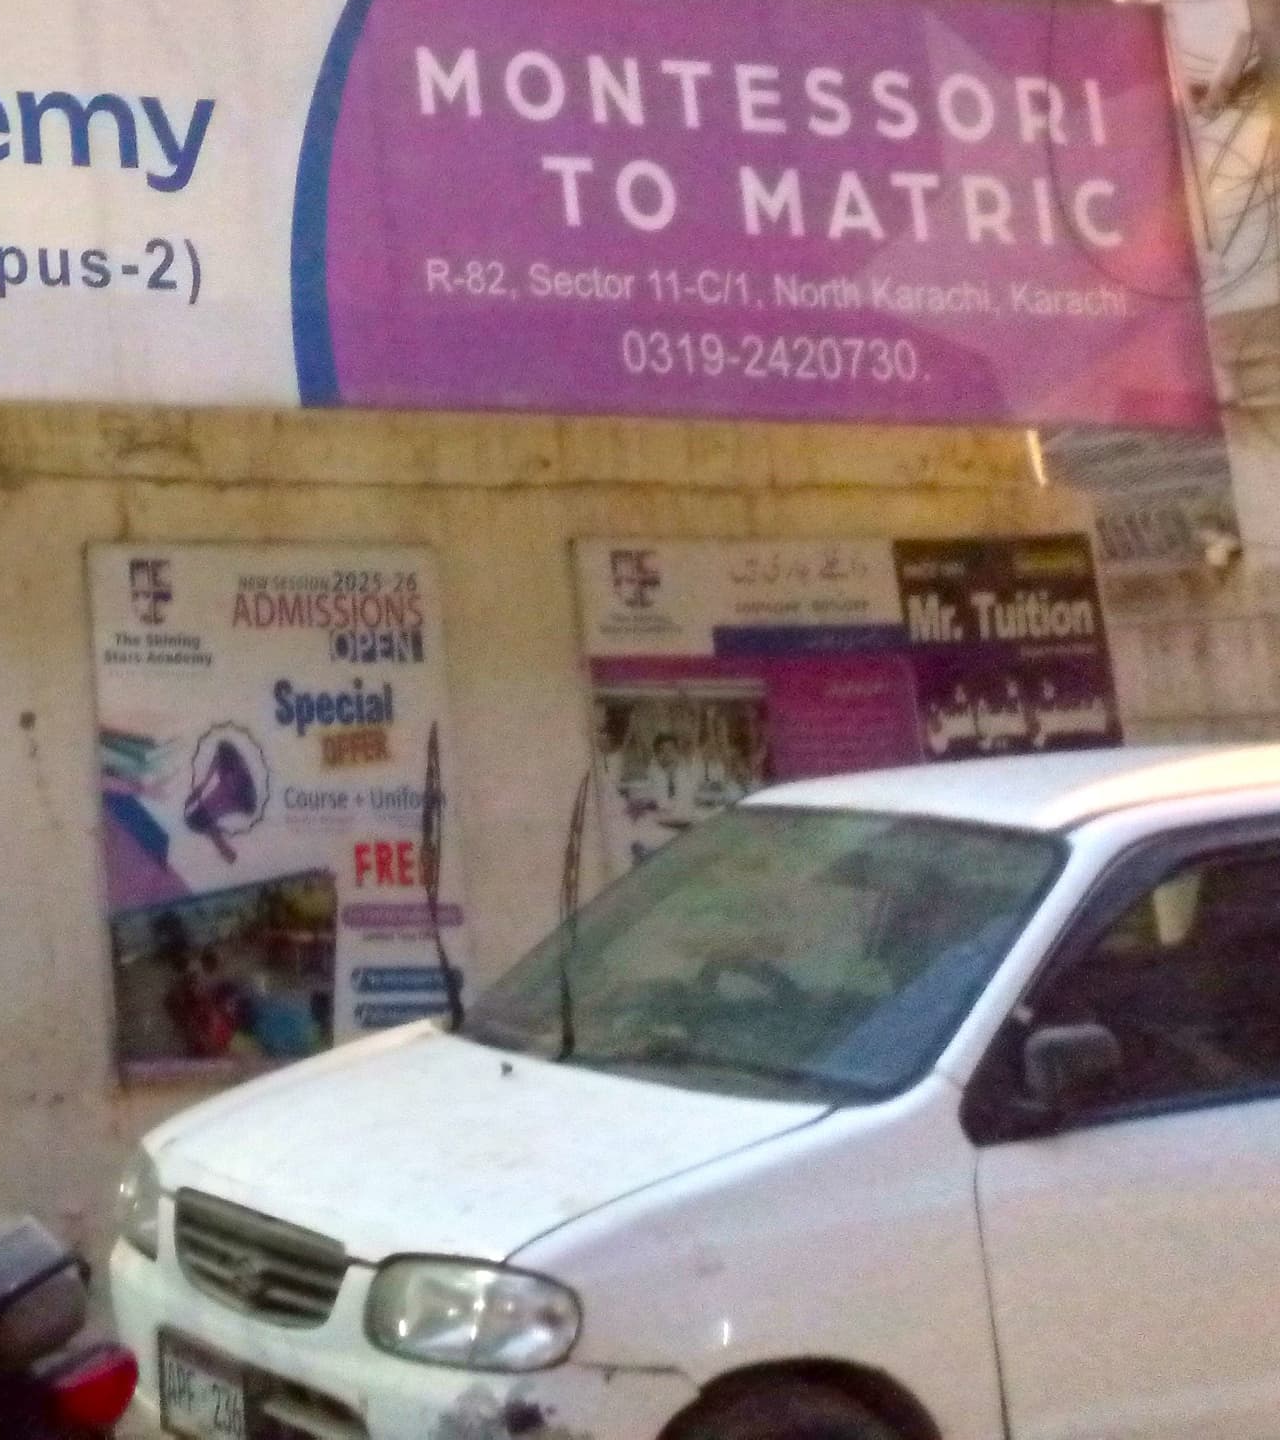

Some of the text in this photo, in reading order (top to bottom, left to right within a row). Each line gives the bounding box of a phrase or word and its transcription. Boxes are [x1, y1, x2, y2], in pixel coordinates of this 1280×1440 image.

[412, 44, 1109, 148] MONTESSORI
[540, 154, 1128, 250] TO MATRIC
[527, 264, 635, 302] Sector
[771, 272, 861, 311] North
[231, 590, 425, 629] ADMISSIONS
[907, 590, 1094, 642] Mr. Tuition
[273, 675, 395, 738] Special
[284, 787, 348, 811] Course
[353, 840, 438, 888] FRE
